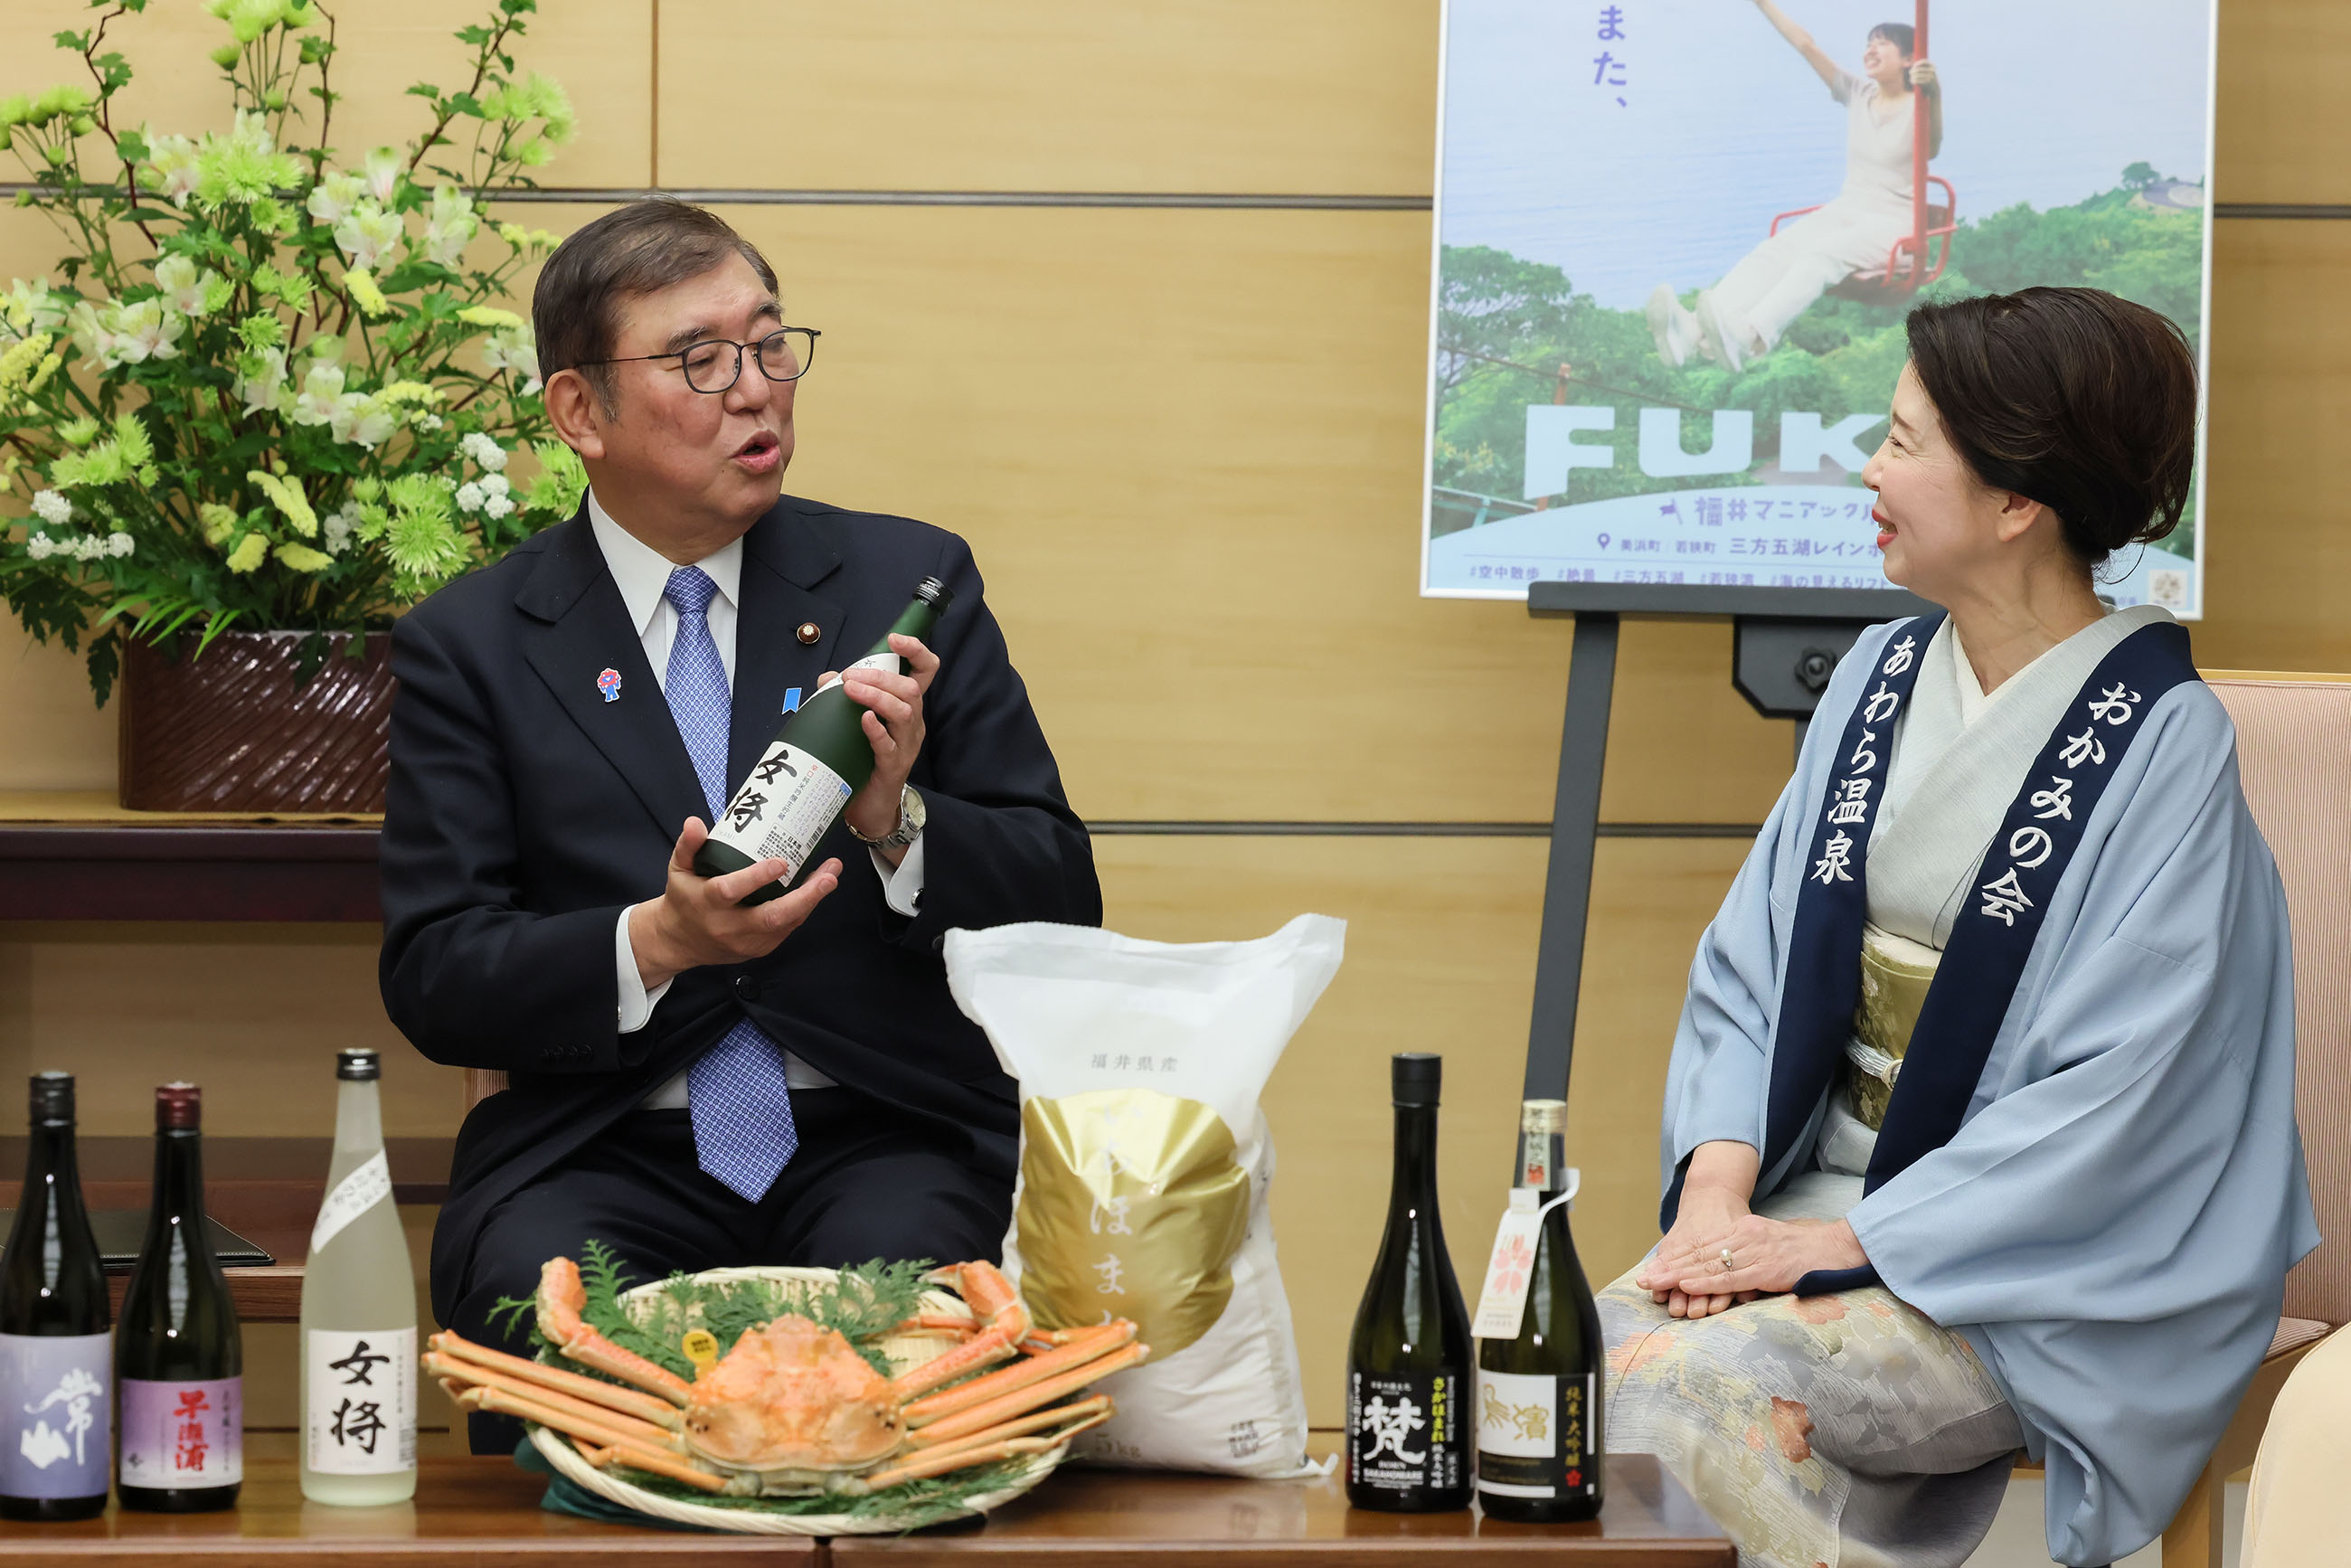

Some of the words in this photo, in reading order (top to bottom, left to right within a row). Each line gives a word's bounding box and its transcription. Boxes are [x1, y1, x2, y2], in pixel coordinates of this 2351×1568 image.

[1592, 5, 1627, 108] また、
[722, 749, 798, 834] 女将
[1810, 635, 1914, 884] あわら温泉
[1981, 681, 2142, 927] おかみの会
[1091, 1053, 1179, 1072] 福井県産
[328, 1340, 391, 1454] 女将
[1362, 1395, 1427, 1465] 梵
